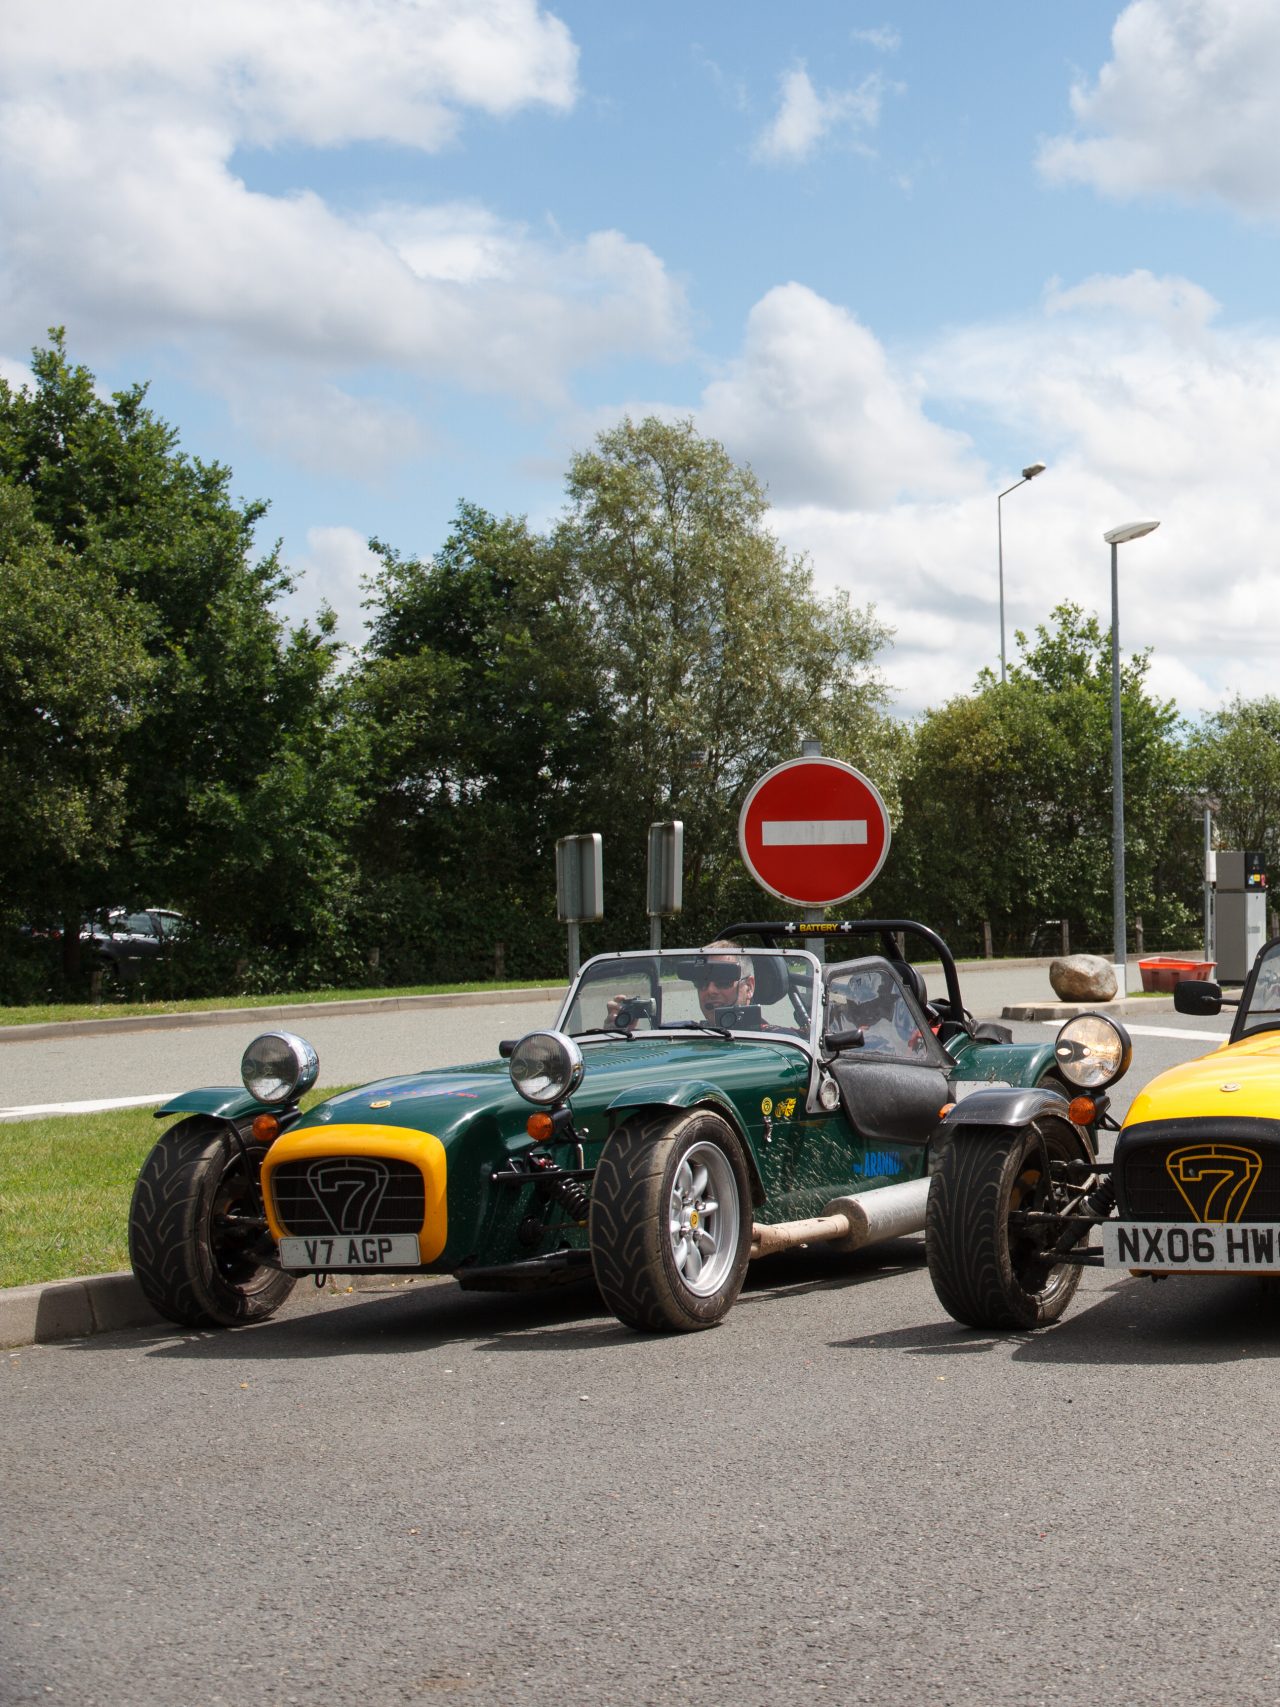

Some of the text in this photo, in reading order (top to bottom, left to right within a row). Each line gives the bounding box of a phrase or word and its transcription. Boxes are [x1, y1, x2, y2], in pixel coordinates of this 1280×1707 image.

[800, 923, 838, 932] BATTERY
[1179, 1154, 1250, 1224] 7
[304, 1237, 393, 1265] V7 AGP
[1117, 1227, 1215, 1263] NX06
